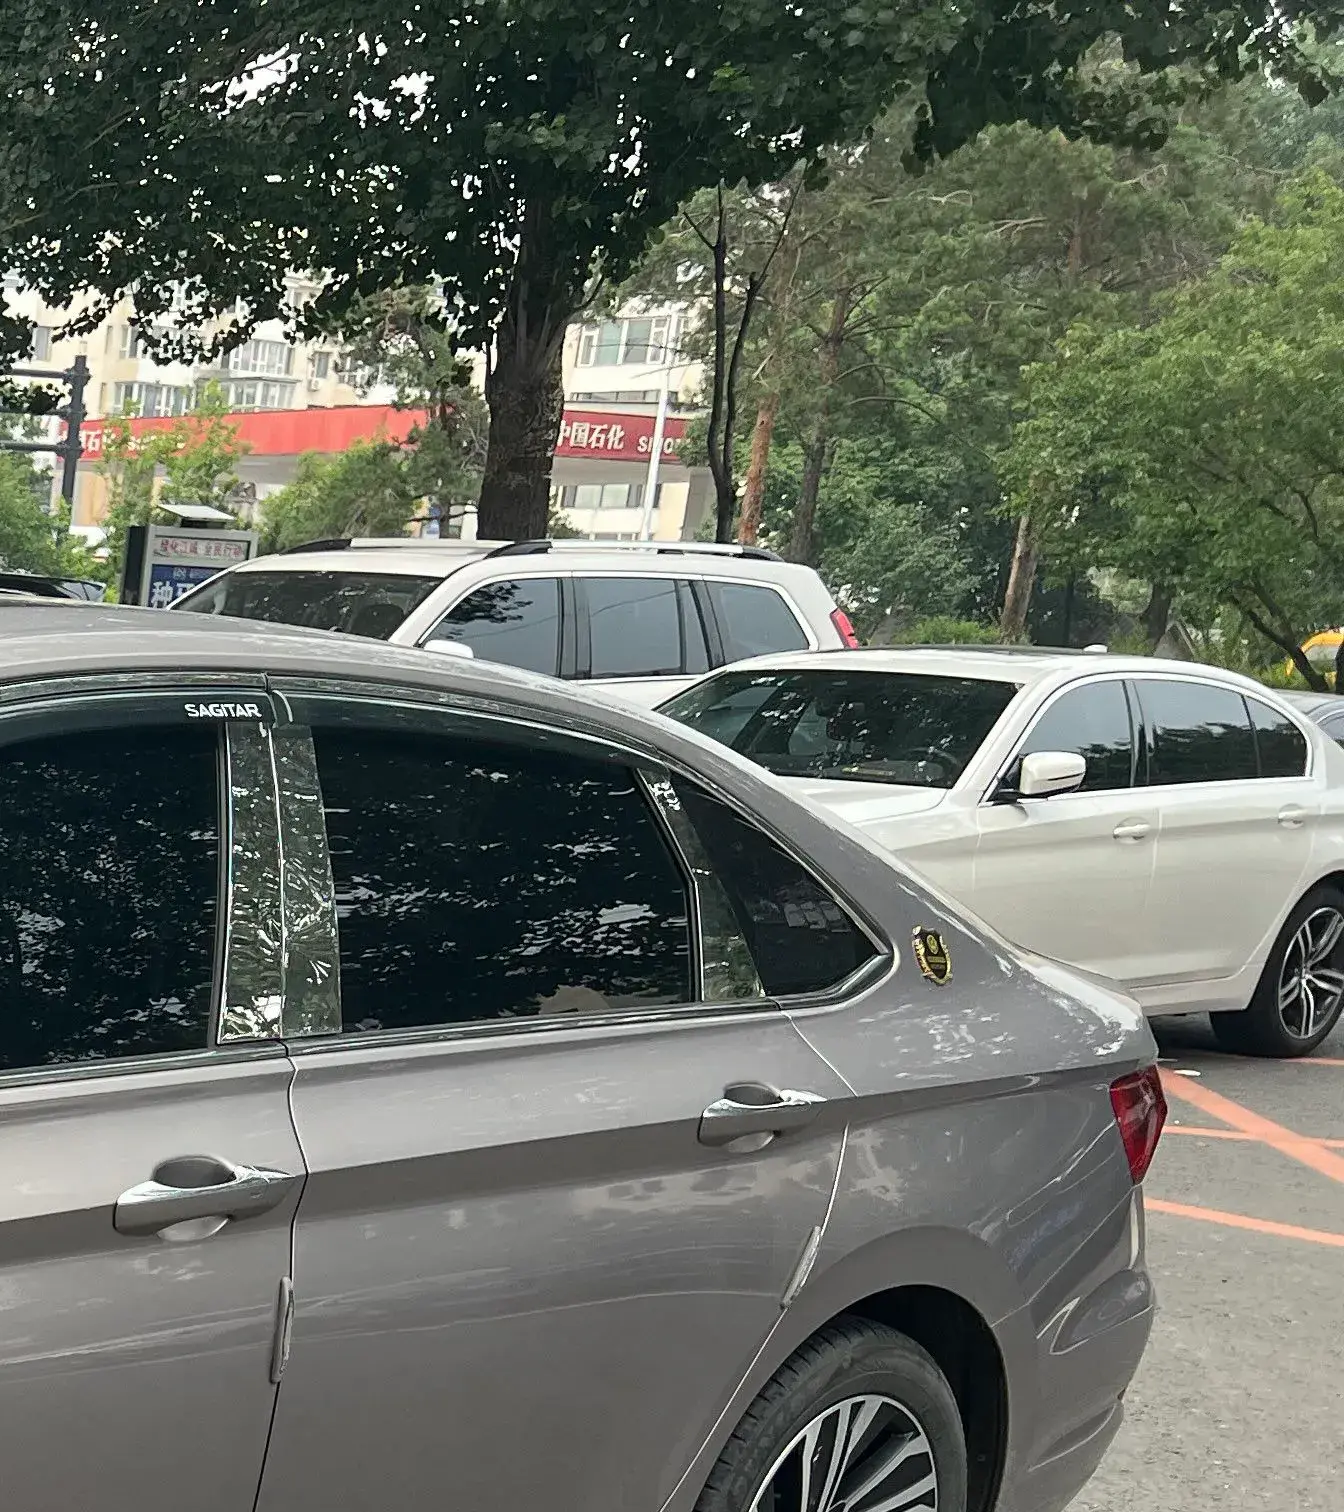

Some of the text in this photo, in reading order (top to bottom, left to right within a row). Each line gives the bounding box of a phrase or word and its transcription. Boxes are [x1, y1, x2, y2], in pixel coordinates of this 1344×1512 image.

[557, 420, 625, 450] 中国石化
[184, 703, 262, 718] SAGITAR
